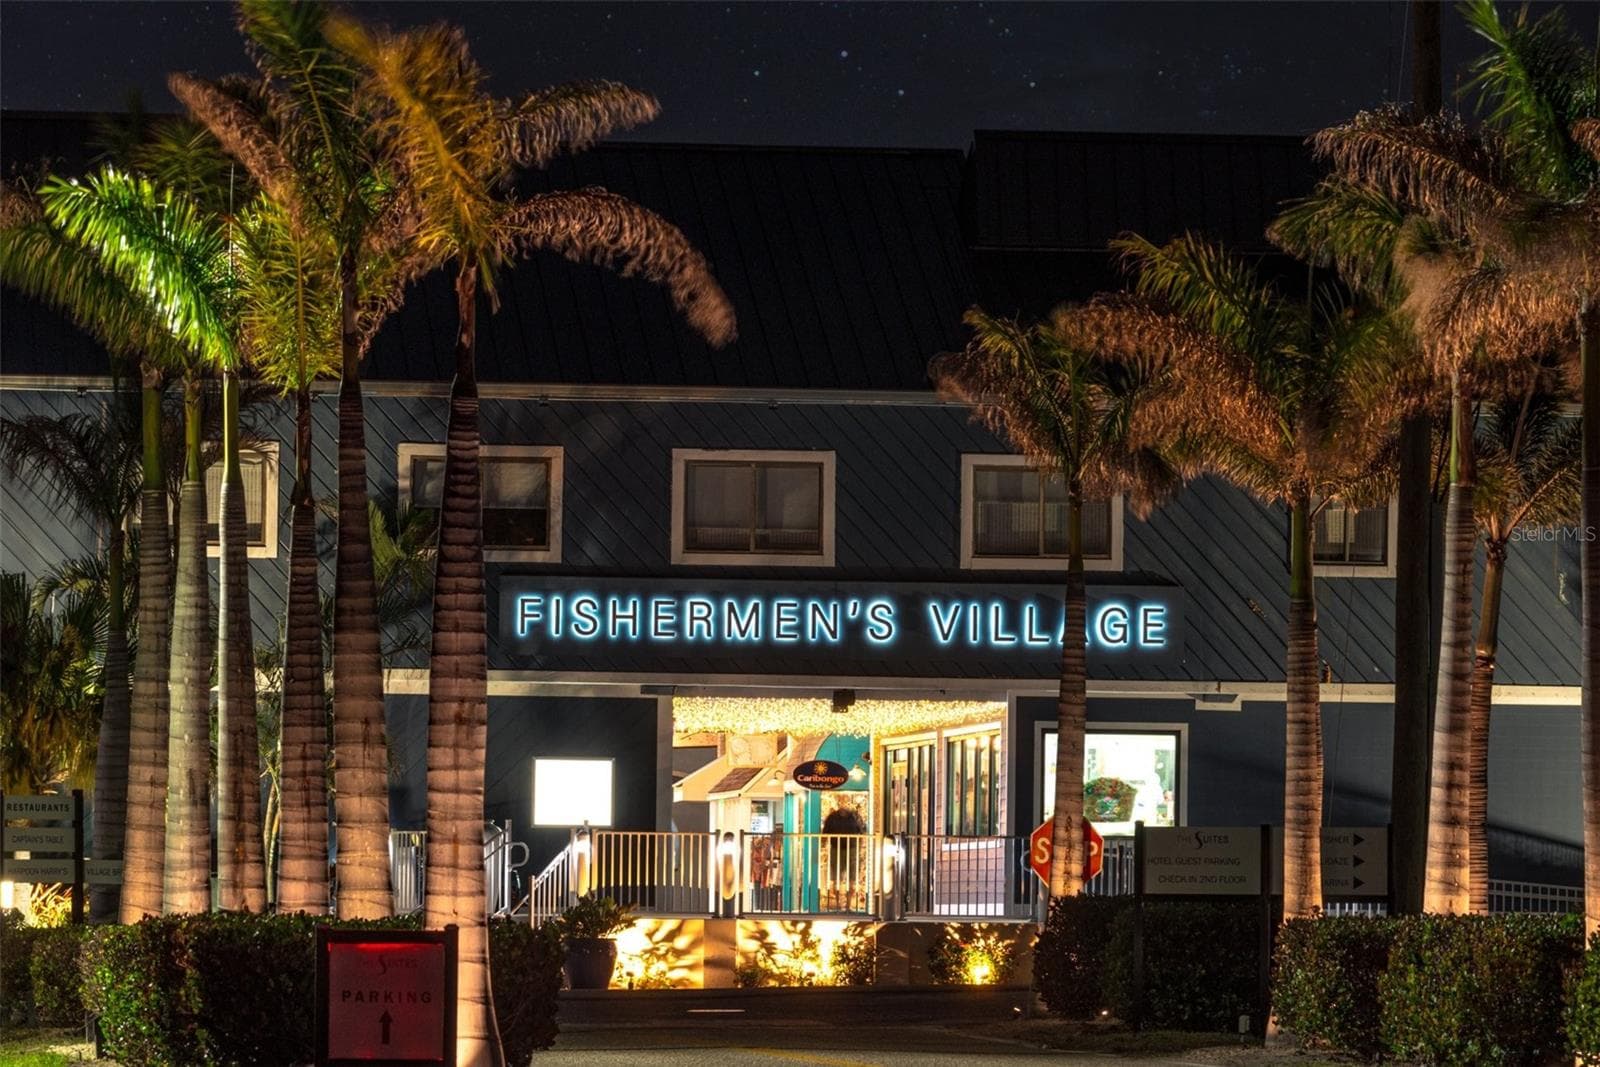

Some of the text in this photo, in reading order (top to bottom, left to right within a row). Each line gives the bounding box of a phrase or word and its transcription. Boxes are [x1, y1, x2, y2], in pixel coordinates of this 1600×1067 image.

[518, 596, 1166, 646] FISHERMEN'S VILLGE
[797, 774, 845, 784] Caribongo
[6, 803, 70, 812] RESTAURANTS
[45, 835, 64, 844] TABLE
[1147, 856, 1241, 866] HOTEL GUEST PARKING
[86, 867, 110, 877] VILLAGE
[1219, 875, 1247, 884] FLOOR
[341, 990, 433, 1004] PARKING
